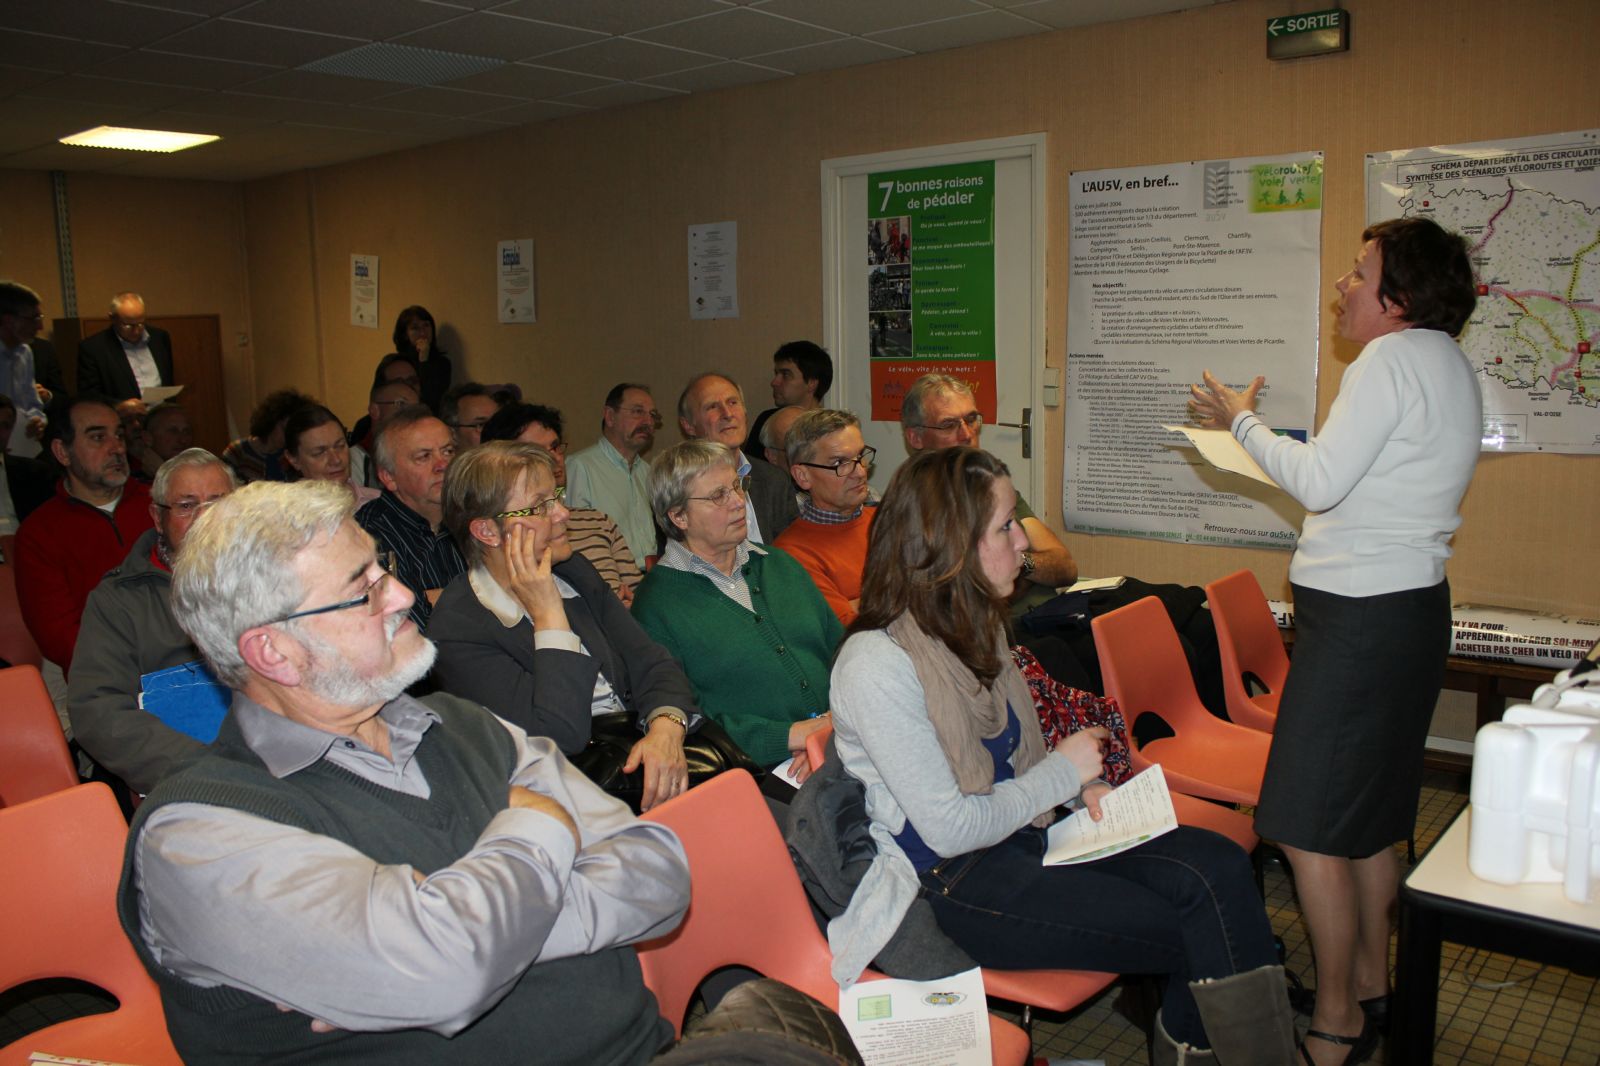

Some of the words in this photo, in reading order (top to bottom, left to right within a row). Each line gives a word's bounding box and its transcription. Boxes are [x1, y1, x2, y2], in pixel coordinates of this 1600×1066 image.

[1287, 13, 1340, 32] SORTIE
[1533, 153, 1549, 161] DES
[1551, 149, 1600, 160] CIRCULATI
[1445, 170, 1459, 179] DES
[1082, 180, 1122, 193] L'AU5V,
[1126, 181, 1140, 190] en
[1143, 175, 1178, 188] bref...
[878, 181, 894, 212] 7
[896, 179, 942, 193] bonnes
[944, 176, 984, 188] raisons
[908, 198, 920, 209] de
[924, 191, 974, 210] pédaler
[1204, 524, 1256, 536] Retrouvez-nous
[1270, 531, 1295, 540] au5v.fr
[1456, 643, 1491, 653] ACHETER
[1494, 646, 1510, 654] PAS
[1512, 646, 1534, 656] CHER
[1536, 648, 1548, 657] UN
[1550, 649, 1571, 659] VELO
[1553, 638, 1596, 648] SOI-MEM
